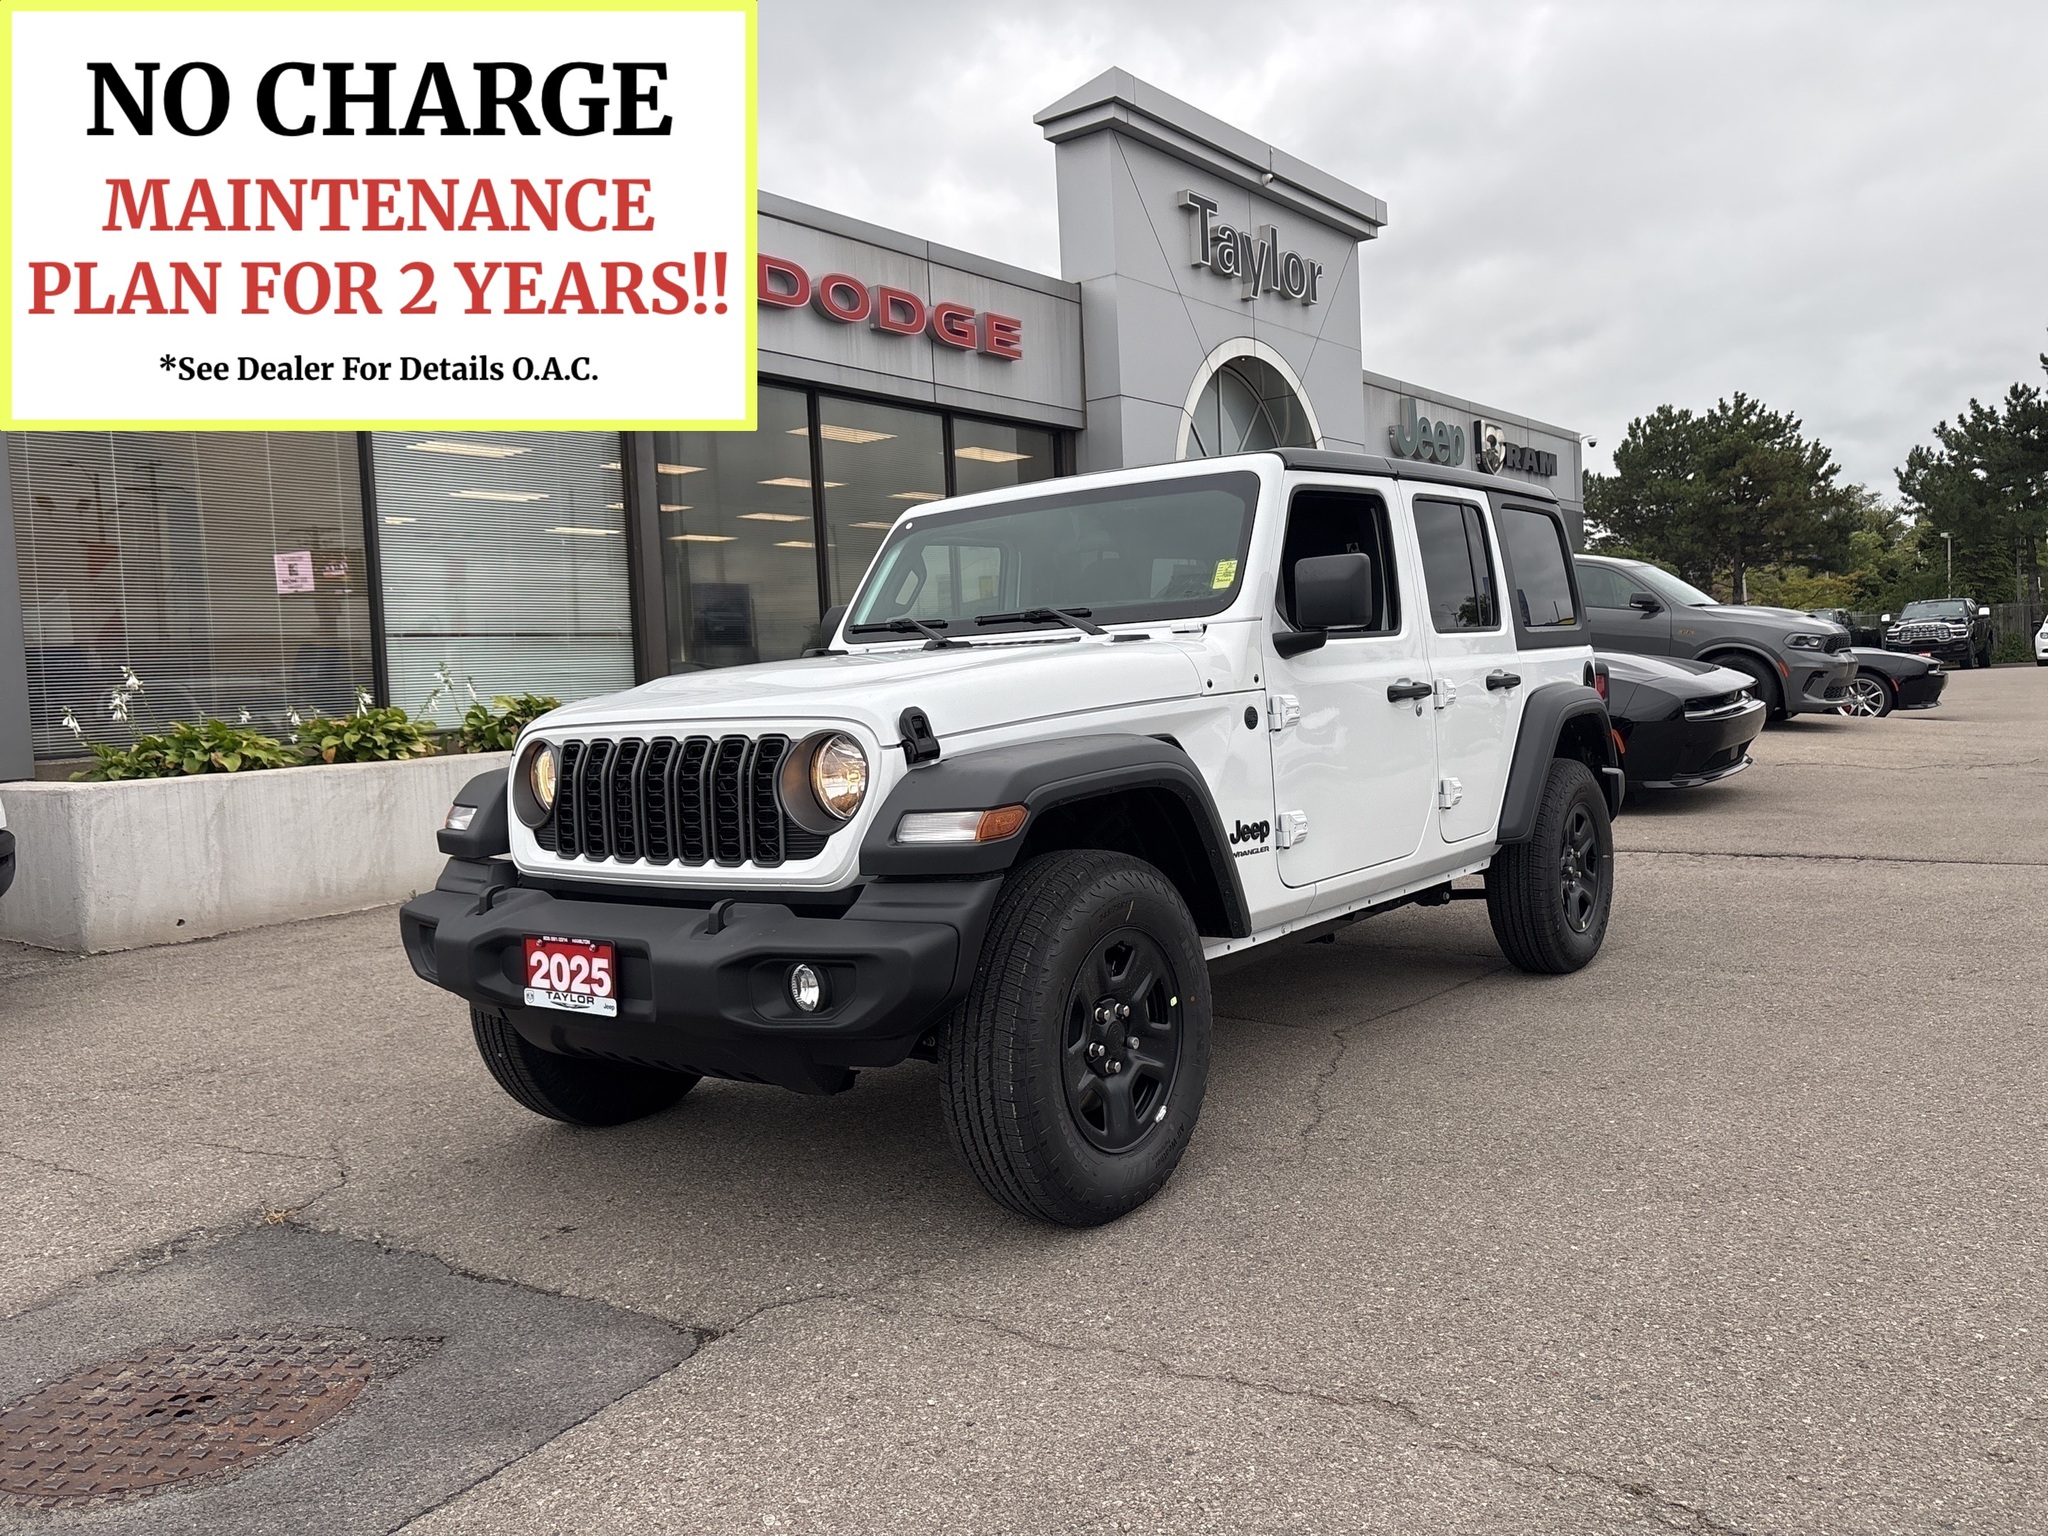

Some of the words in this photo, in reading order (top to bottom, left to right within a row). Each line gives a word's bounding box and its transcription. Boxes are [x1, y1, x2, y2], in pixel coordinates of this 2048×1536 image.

[1177, 189, 1323, 306] Taylor
[757, 253, 1022, 361] DODGE
[1389, 397, 1465, 467] Jeep
[1503, 442, 1557, 476] RAM
[1230, 820, 1270, 844] Jeep
[529, 950, 611, 997] 2025
[545, 991, 595, 1005] TAYLOR
[603, 1003, 615, 1012] Jeep
